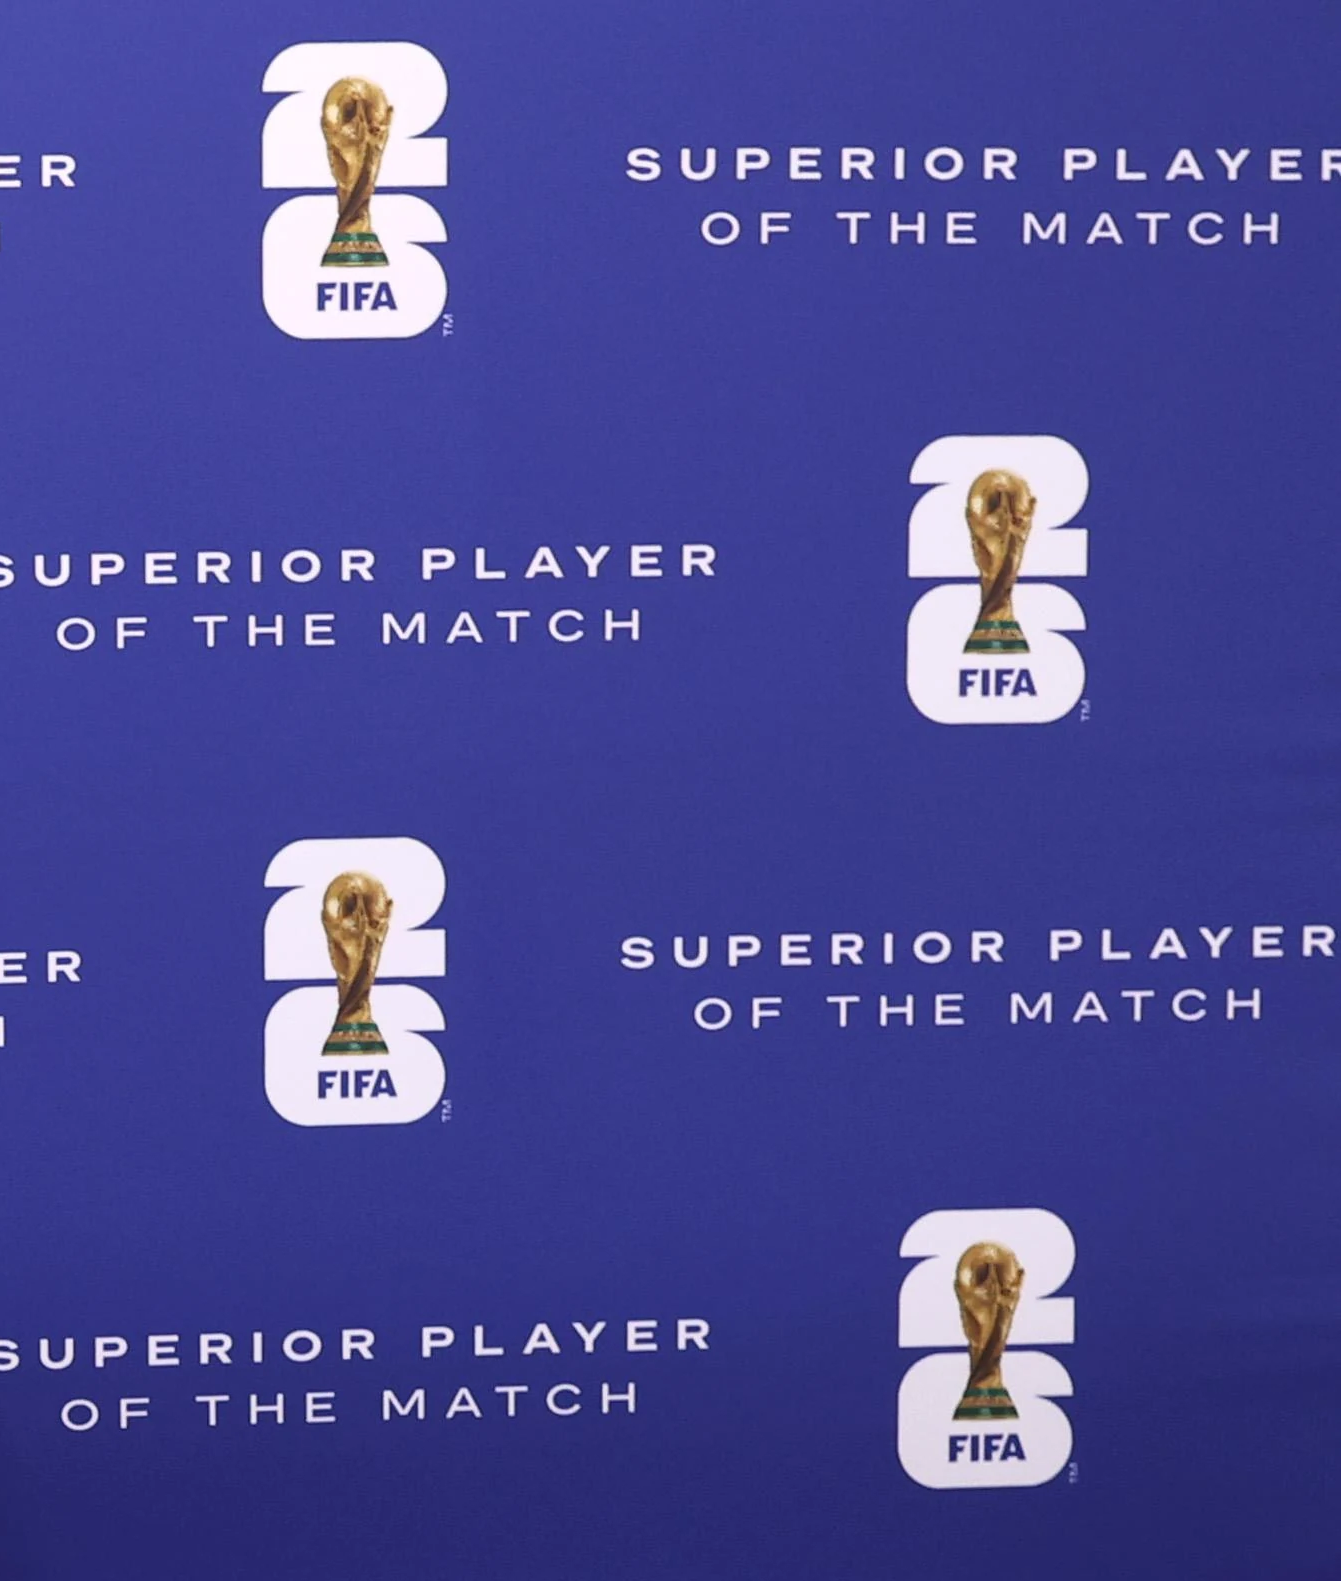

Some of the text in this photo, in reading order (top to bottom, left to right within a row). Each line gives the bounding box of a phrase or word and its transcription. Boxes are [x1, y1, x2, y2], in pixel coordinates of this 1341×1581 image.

[625, 146, 1341, 182] SUPERIOR PLAYER
[700, 211, 1280, 246] OF THE MATCH
[317, 281, 398, 312] FIFA
[421, 543, 716, 581] PLAYER
[56, 608, 640, 651] OF THE MATCH
[958, 668, 1037, 697] FIFA
[620, 924, 1336, 970] SUPERIOR PLAYER
[693, 987, 1261, 1031] OF THE MATCH
[317, 1069, 397, 1099] FIFA
[421, 1318, 710, 1358] PLAYER
[60, 1381, 636, 1432] OF THE MATCH
[948, 1433, 1026, 1463] FIFA
